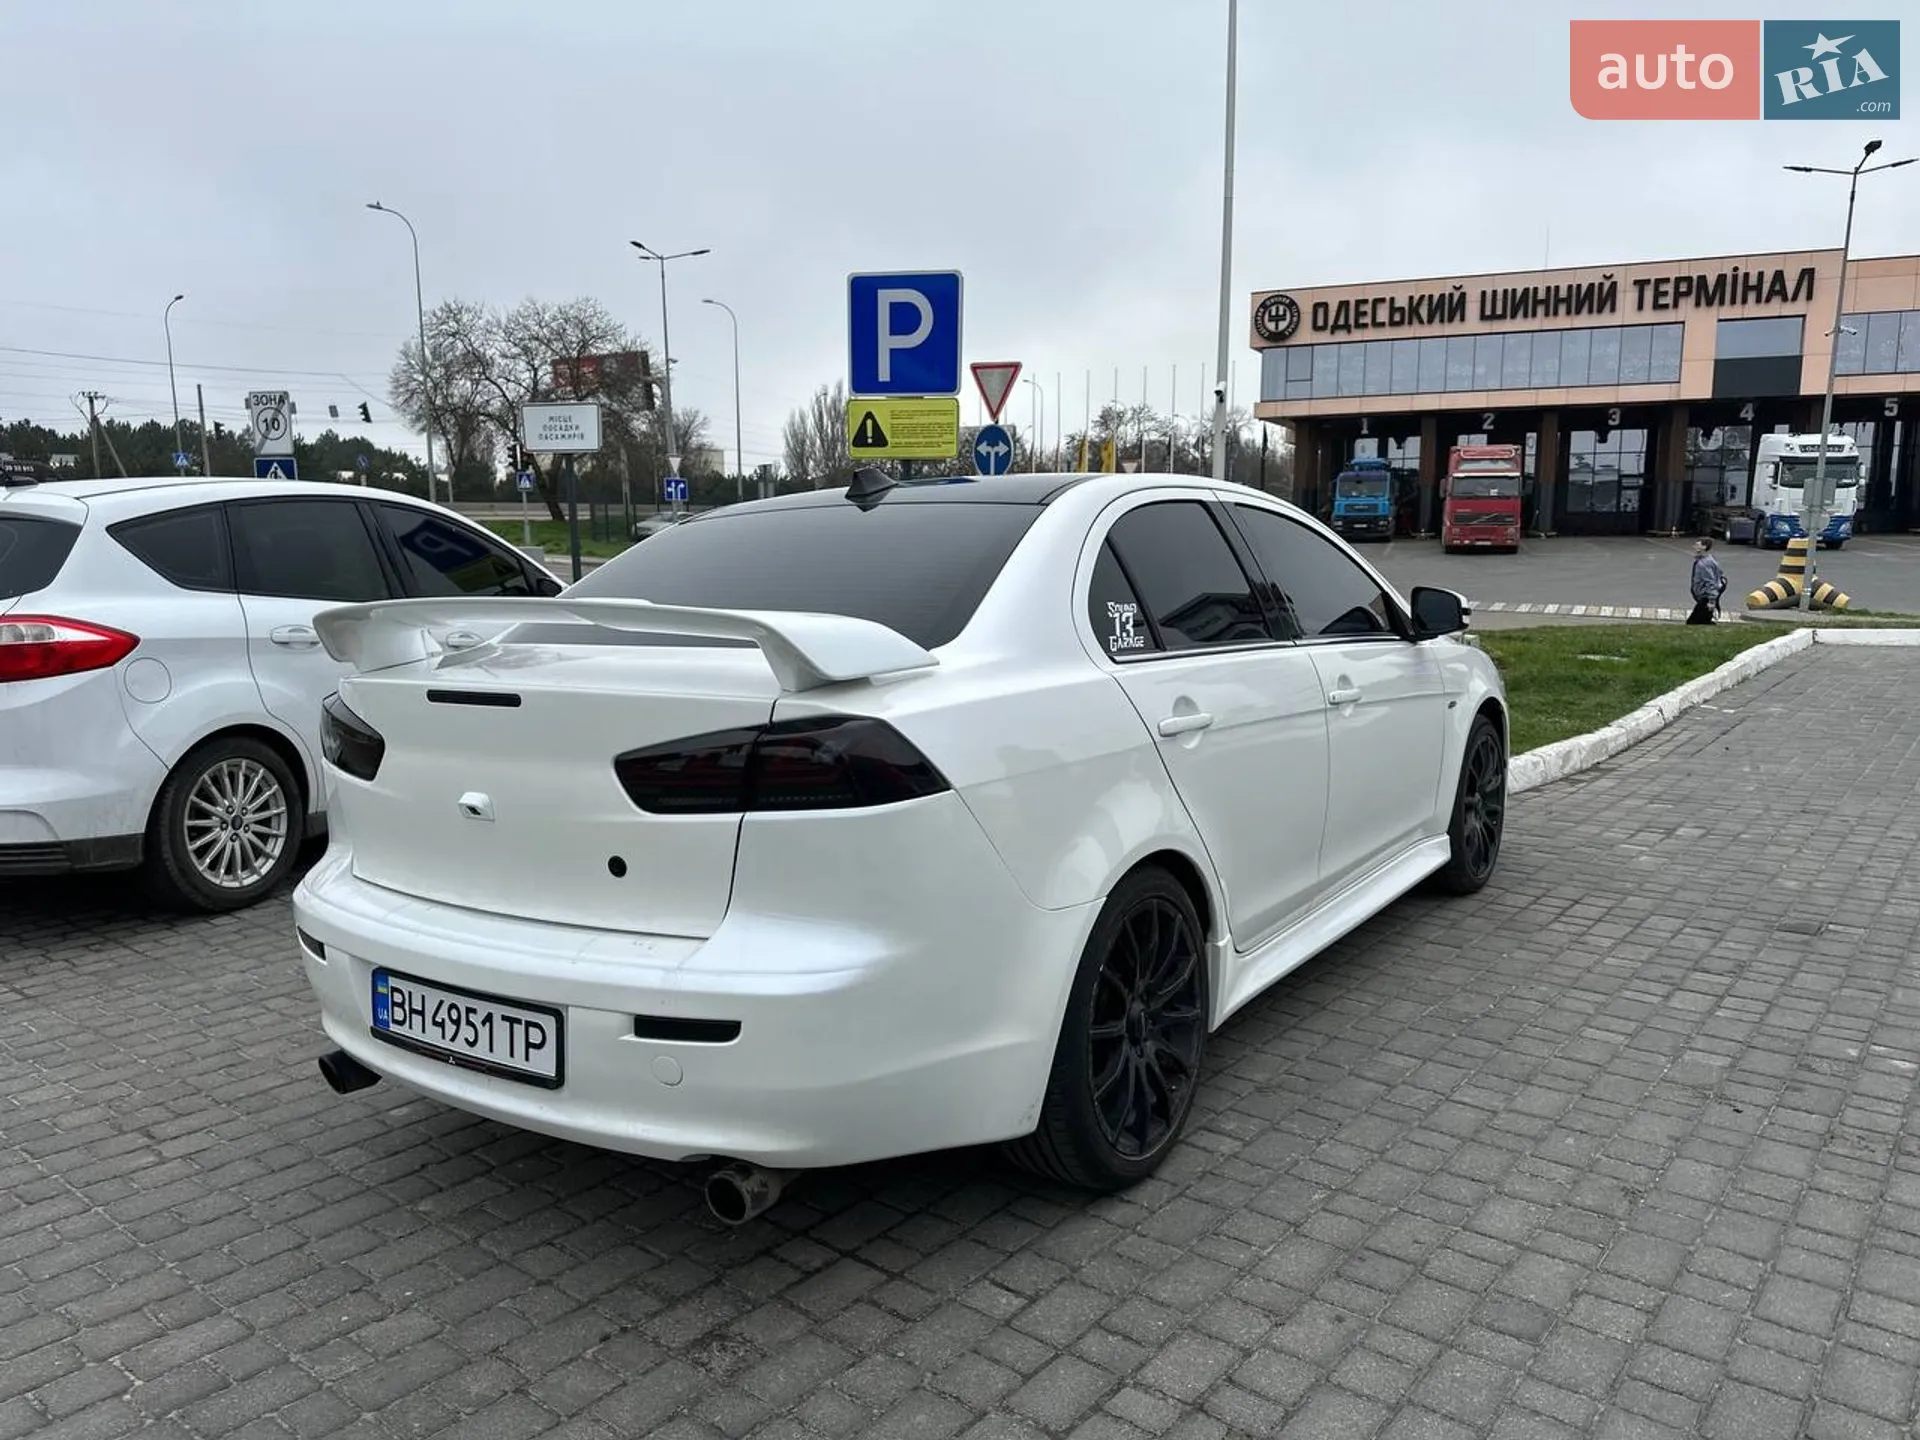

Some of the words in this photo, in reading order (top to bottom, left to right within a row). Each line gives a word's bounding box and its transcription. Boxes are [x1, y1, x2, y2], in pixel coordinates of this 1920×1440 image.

[1311, 284, 1467, 335] ОДЕСЬКИЙ
[1479, 273, 1619, 321] ШИННИЙ
[877, 288, 934, 382] P
[252, 394, 286, 406] ЗОНА
[1884, 398, 1899, 417] 5
[1482, 412, 1495, 430] 2
[1608, 408, 1621, 426] 3
[1739, 403, 1755, 421] 4
[262, 417, 280, 431] 10
[1360, 418, 1370, 435] 1
[1113, 611, 1134, 638] 13
[377, 1007, 389, 1020] UA
